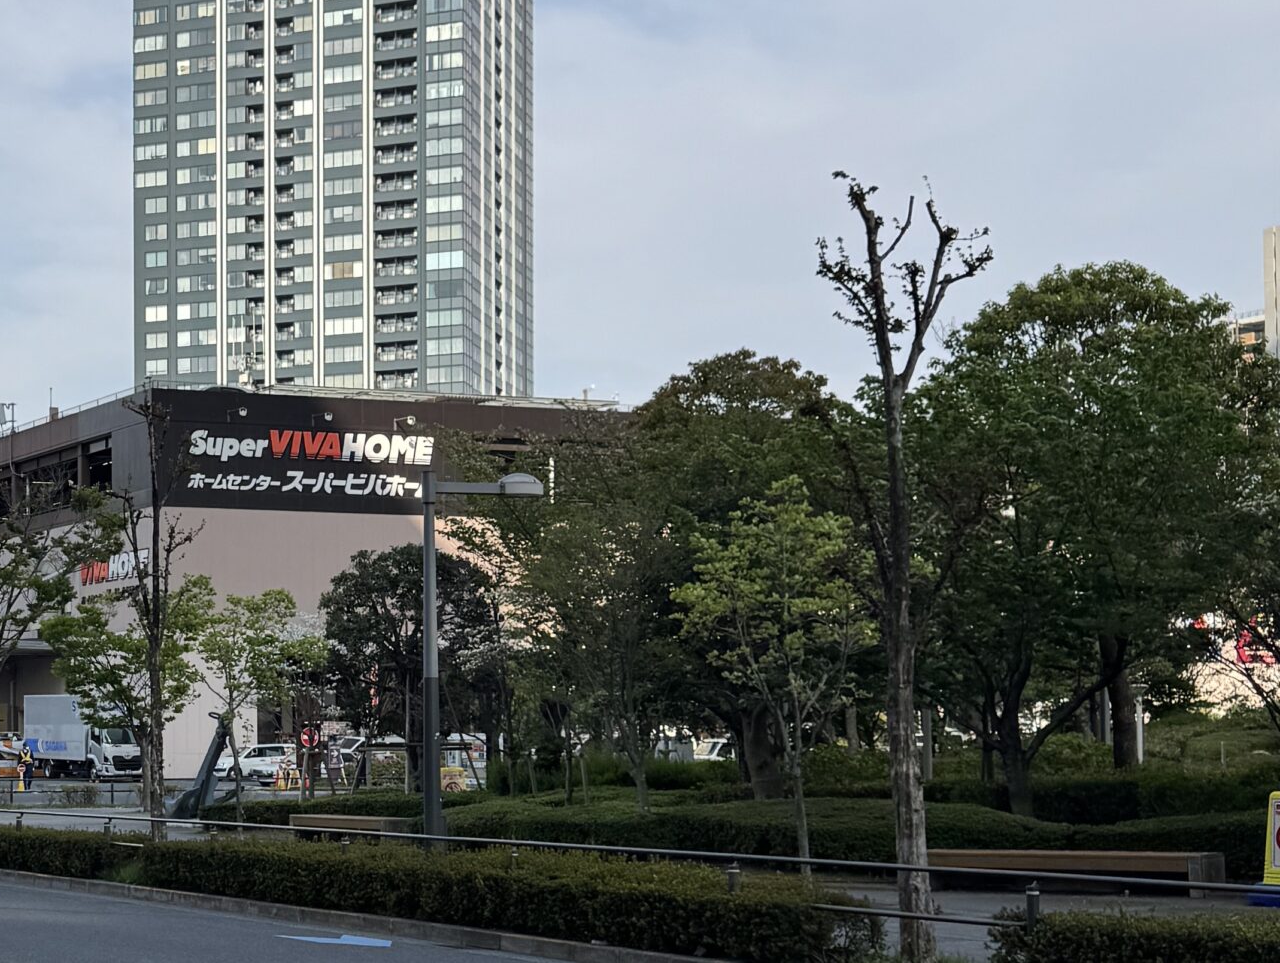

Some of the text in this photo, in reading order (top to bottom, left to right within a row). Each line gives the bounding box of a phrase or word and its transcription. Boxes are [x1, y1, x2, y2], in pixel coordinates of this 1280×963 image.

[188, 429, 435, 466] Super VIVAHOME
[187, 472, 281, 491] ホームセンター
